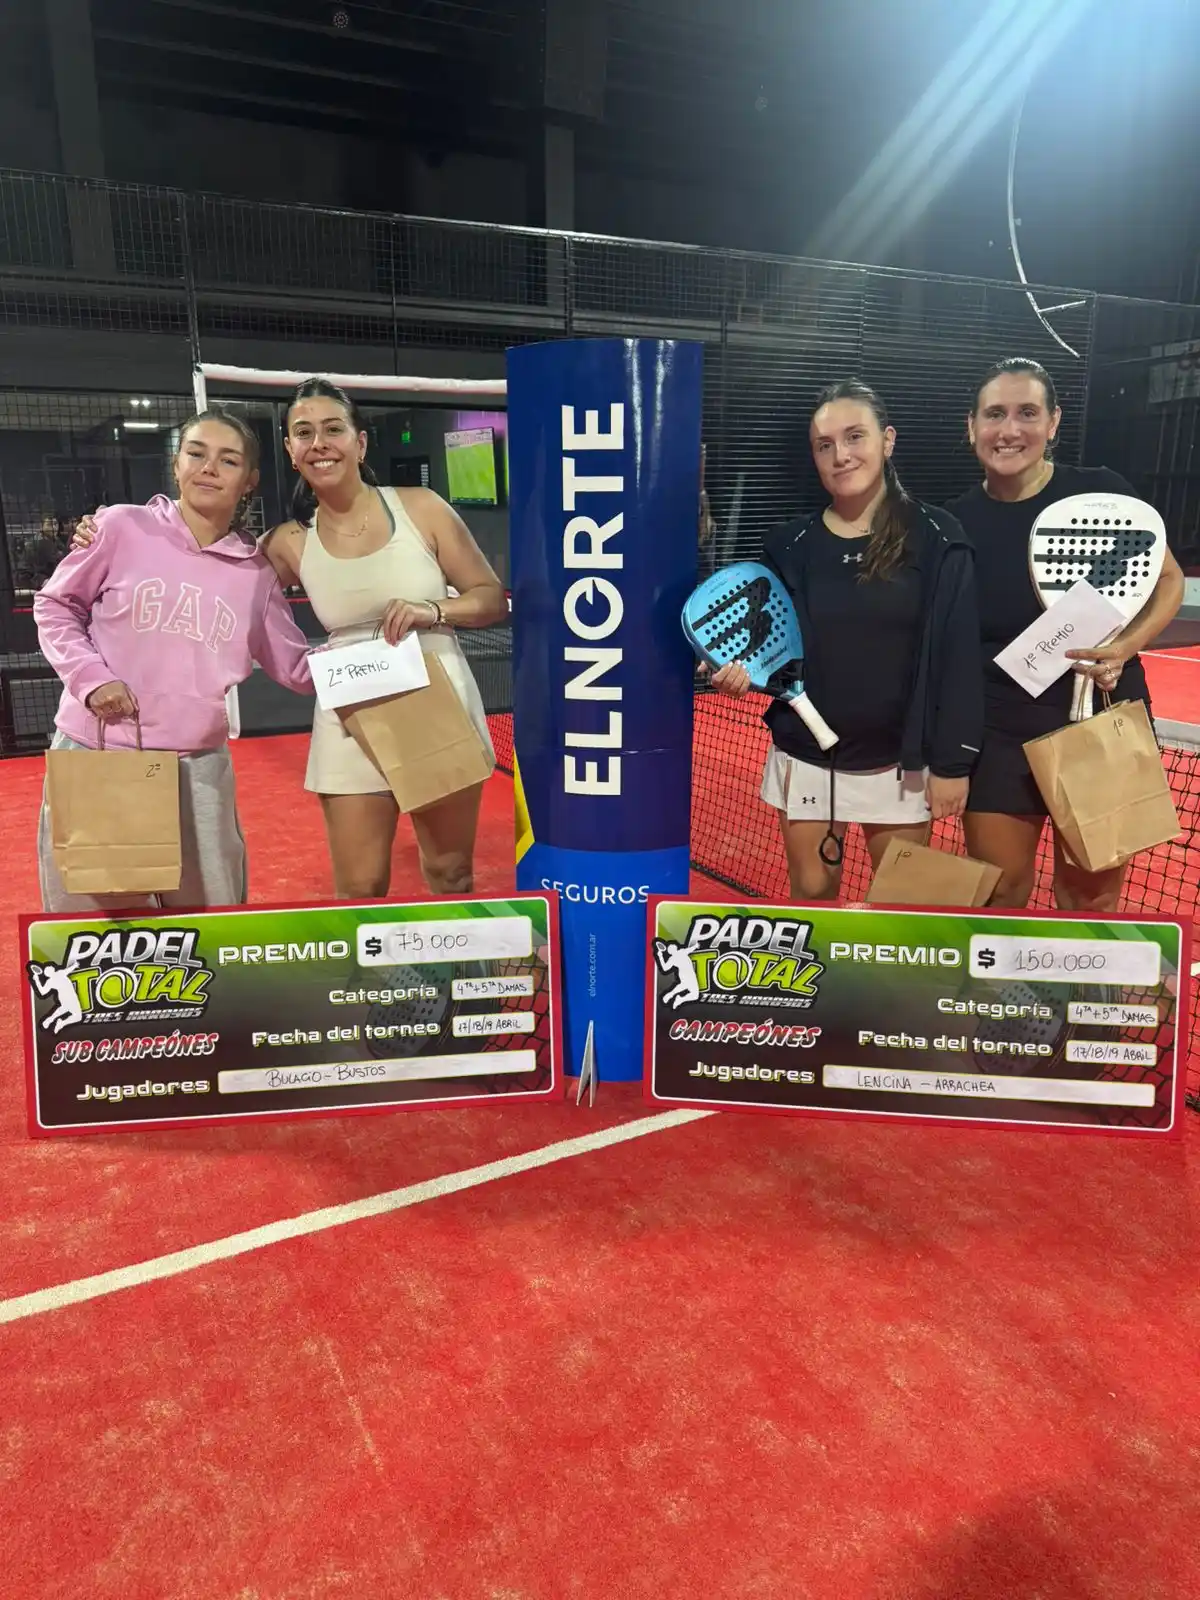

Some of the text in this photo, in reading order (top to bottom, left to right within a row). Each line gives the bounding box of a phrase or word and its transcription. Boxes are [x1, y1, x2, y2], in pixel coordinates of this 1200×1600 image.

[561, 402, 625, 796] ELNORTE
[132, 577, 238, 653] GAP
[344, 660, 389, 679] PREMIO
[67, 931, 203, 969] PADEL
[218, 936, 382, 965] PREMIO $
[395, 932, 468, 951] 75.000
[688, 918, 815, 961] PADEL
[588, 932, 597, 997] elnorte.com.ar
[829, 942, 996, 969] PREMIO $
[1014, 949, 1107, 972] 150.000
[688, 949, 824, 997] TOTAL
[69, 964, 213, 1014] TOTAL
[328, 985, 438, 1006] Categoría
[700, 992, 738, 1005] TRES
[83, 1011, 125, 1024] TRES
[936, 998, 1054, 1020] Categoría
[51, 1029, 219, 1064] SUB CAMPEÓNES
[252, 1023, 441, 1047] Fecha del torneo
[668, 1018, 822, 1048] CAMPEÓNES
[857, 1030, 1054, 1057] Fecha del torneo
[688, 1061, 816, 1084] Jugadores
[76, 1079, 210, 1103] Jugadores
